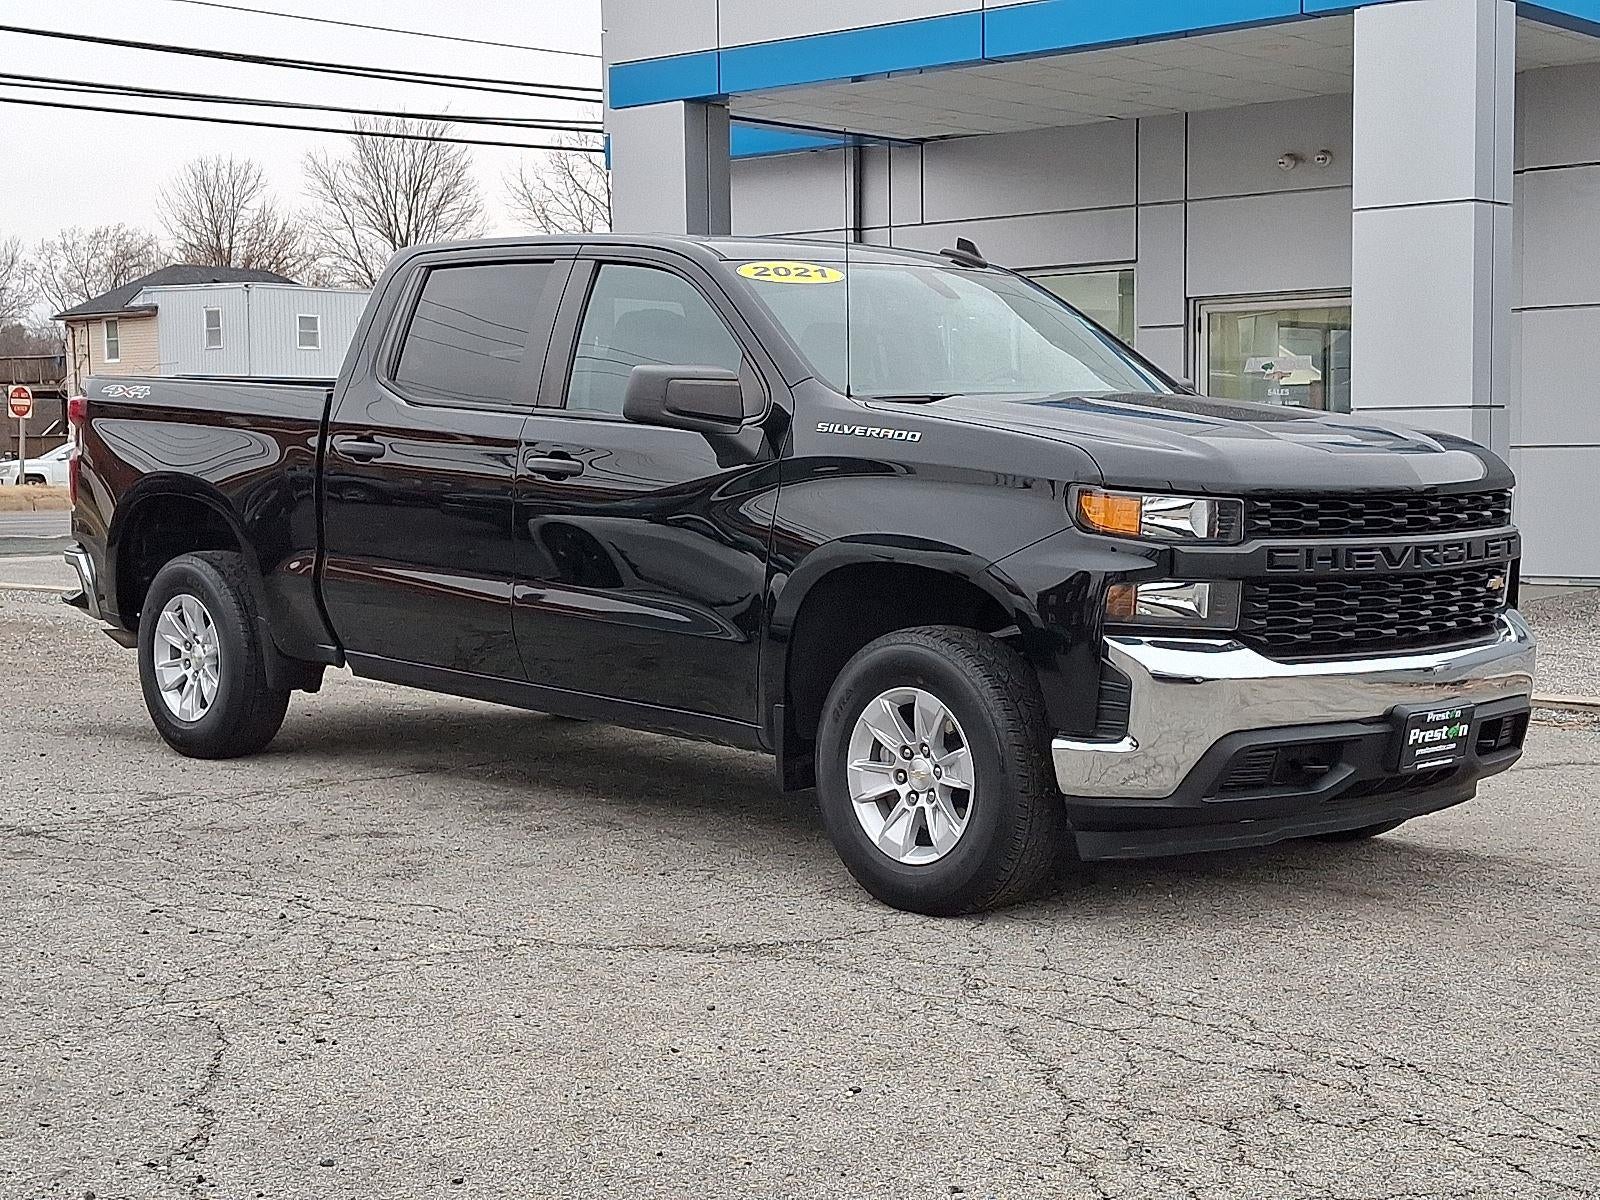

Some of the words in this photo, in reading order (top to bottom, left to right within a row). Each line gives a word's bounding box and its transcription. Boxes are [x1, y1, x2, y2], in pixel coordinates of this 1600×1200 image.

[752, 266, 828, 278] 2021
[1267, 388, 1290, 396] SALES
[816, 422, 923, 442] SILVERADO
[1266, 538, 1517, 572] CHEVROLET
[1408, 722, 1469, 746] Preston
